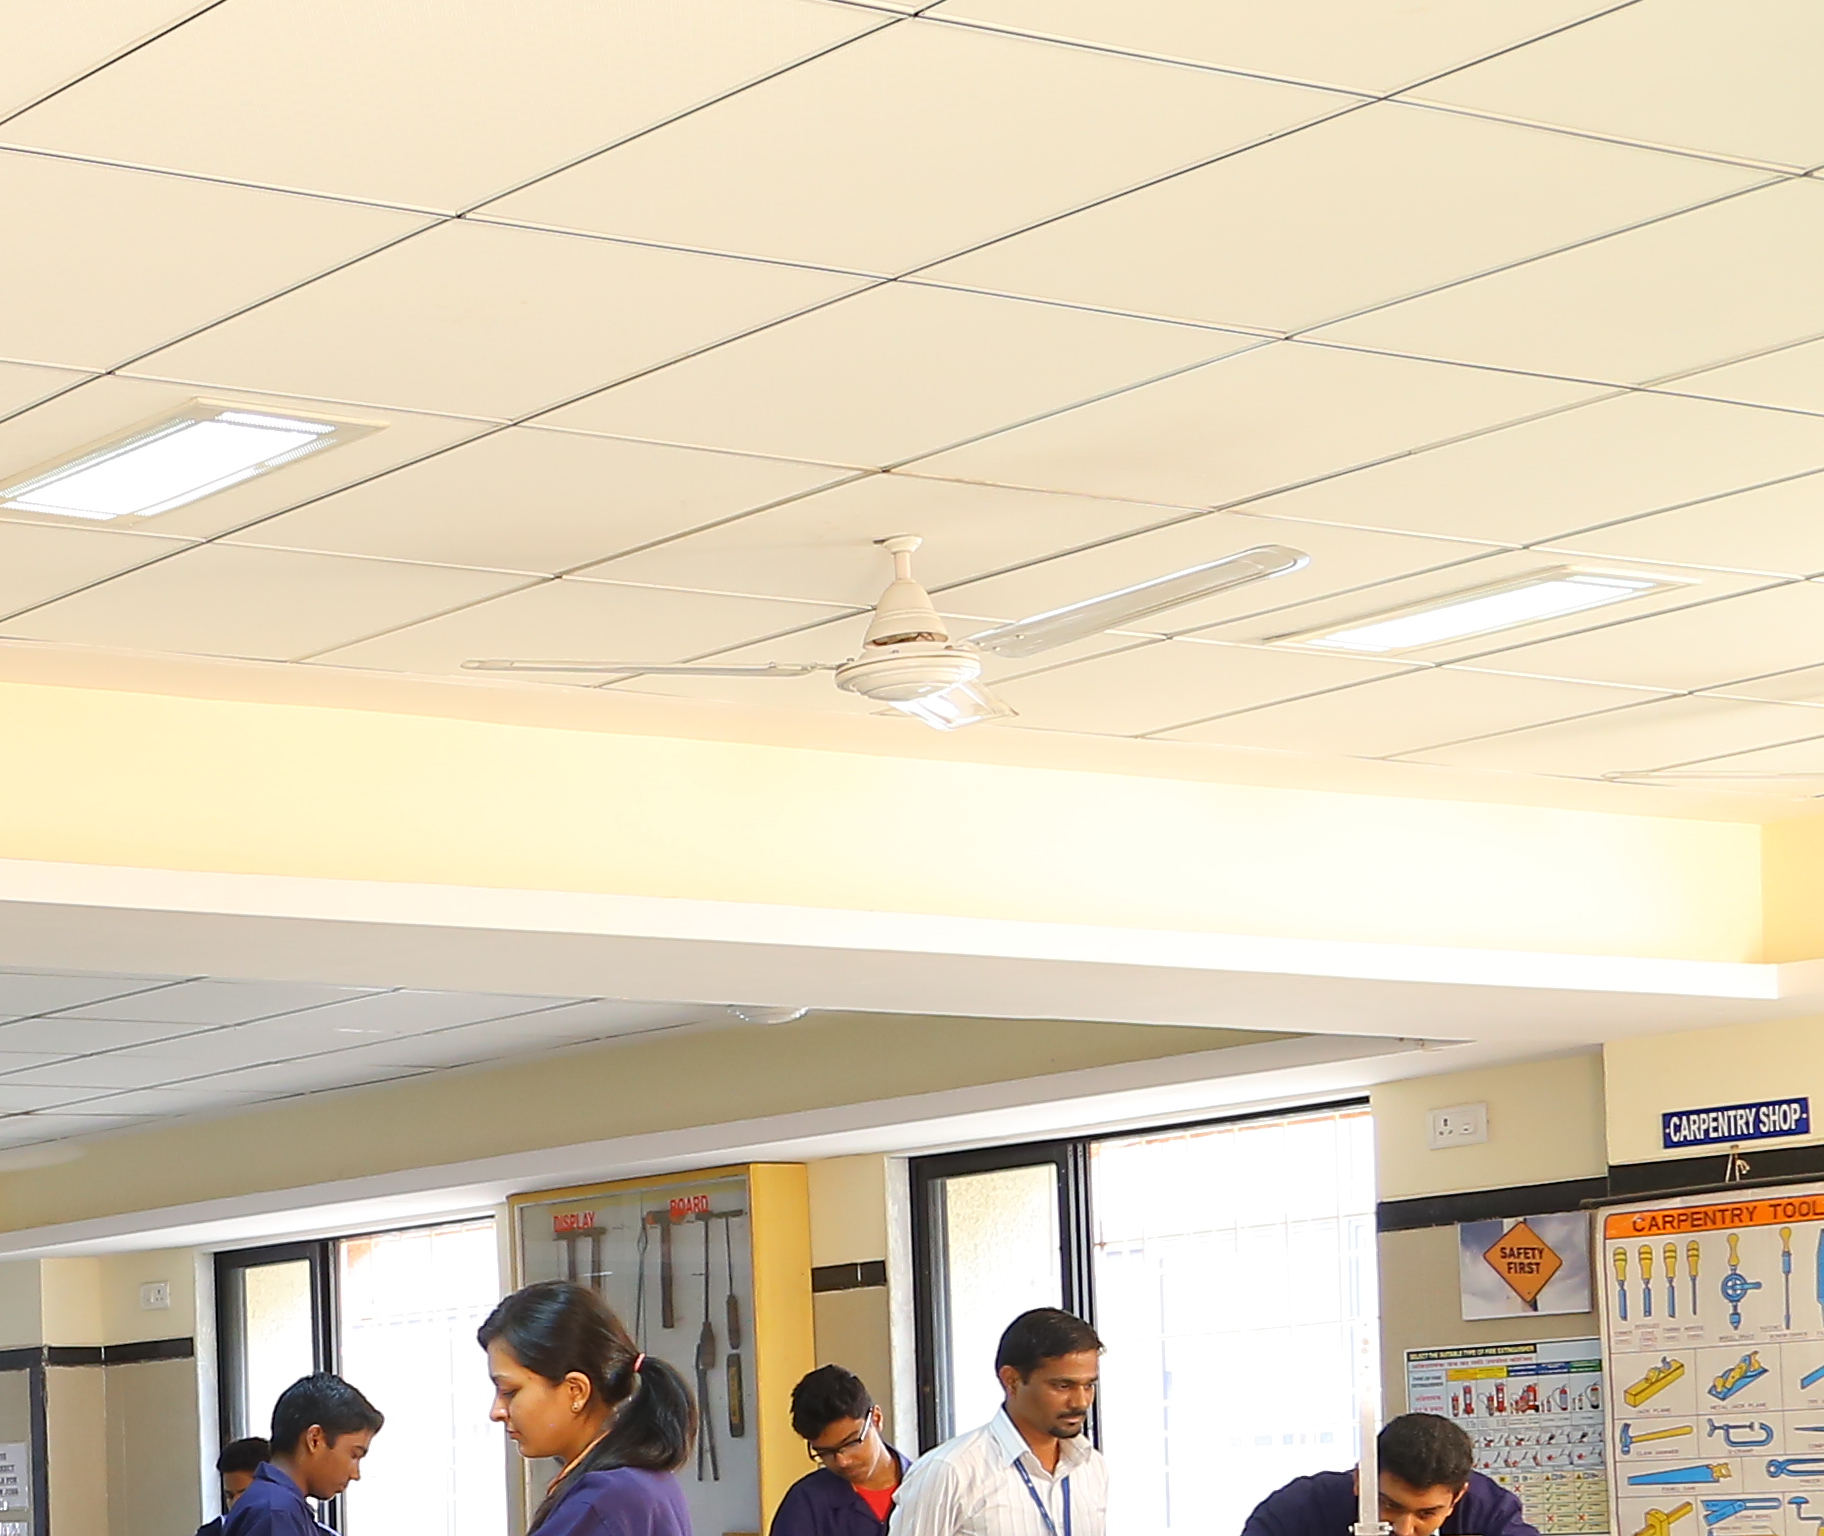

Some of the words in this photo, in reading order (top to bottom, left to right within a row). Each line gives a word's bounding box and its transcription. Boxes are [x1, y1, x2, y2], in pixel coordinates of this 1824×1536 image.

[1669, 1107, 1757, 1142] CARPENTRY
[1759, 1102, 1801, 1133] SHOP
[553, 1211, 596, 1233] DISPLAY
[670, 1194, 710, 1216] BOARD
[1632, 1205, 1758, 1233] CARPENTRY
[1500, 1246, 1545, 1260] SAFETY
[1507, 1261, 1541, 1275] FIRST
